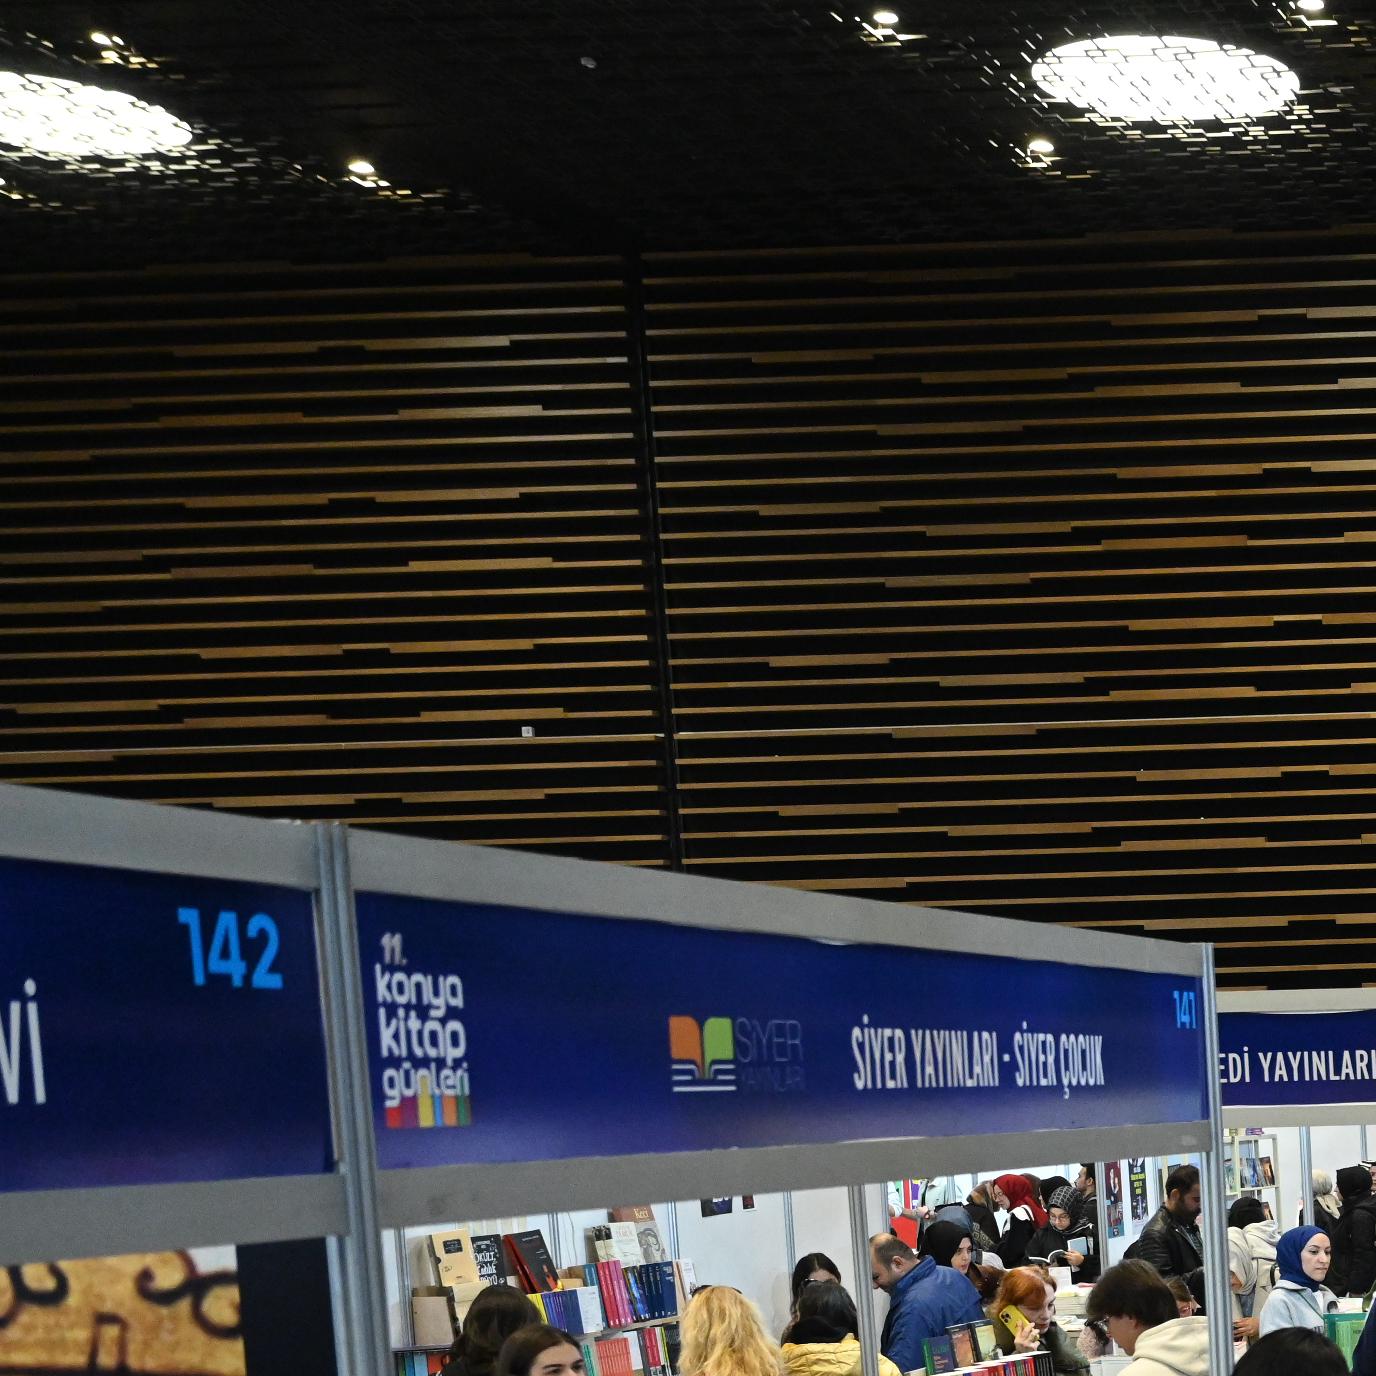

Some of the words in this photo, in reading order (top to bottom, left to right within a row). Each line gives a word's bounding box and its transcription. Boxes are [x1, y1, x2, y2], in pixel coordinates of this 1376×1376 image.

[178, 907, 283, 990] 142
[375, 963, 464, 1017] konya
[1172, 989, 1197, 1030] 141
[378, 1007, 466, 1068] kitap
[851, 1013, 906, 1091] SİYER
[909, 1028, 1000, 1090] YAYINLARI
[1013, 1020, 1057, 1088] SİYER
[1060, 1034, 1105, 1100] ÇOCUK
[382, 1061, 470, 1108] günleri
